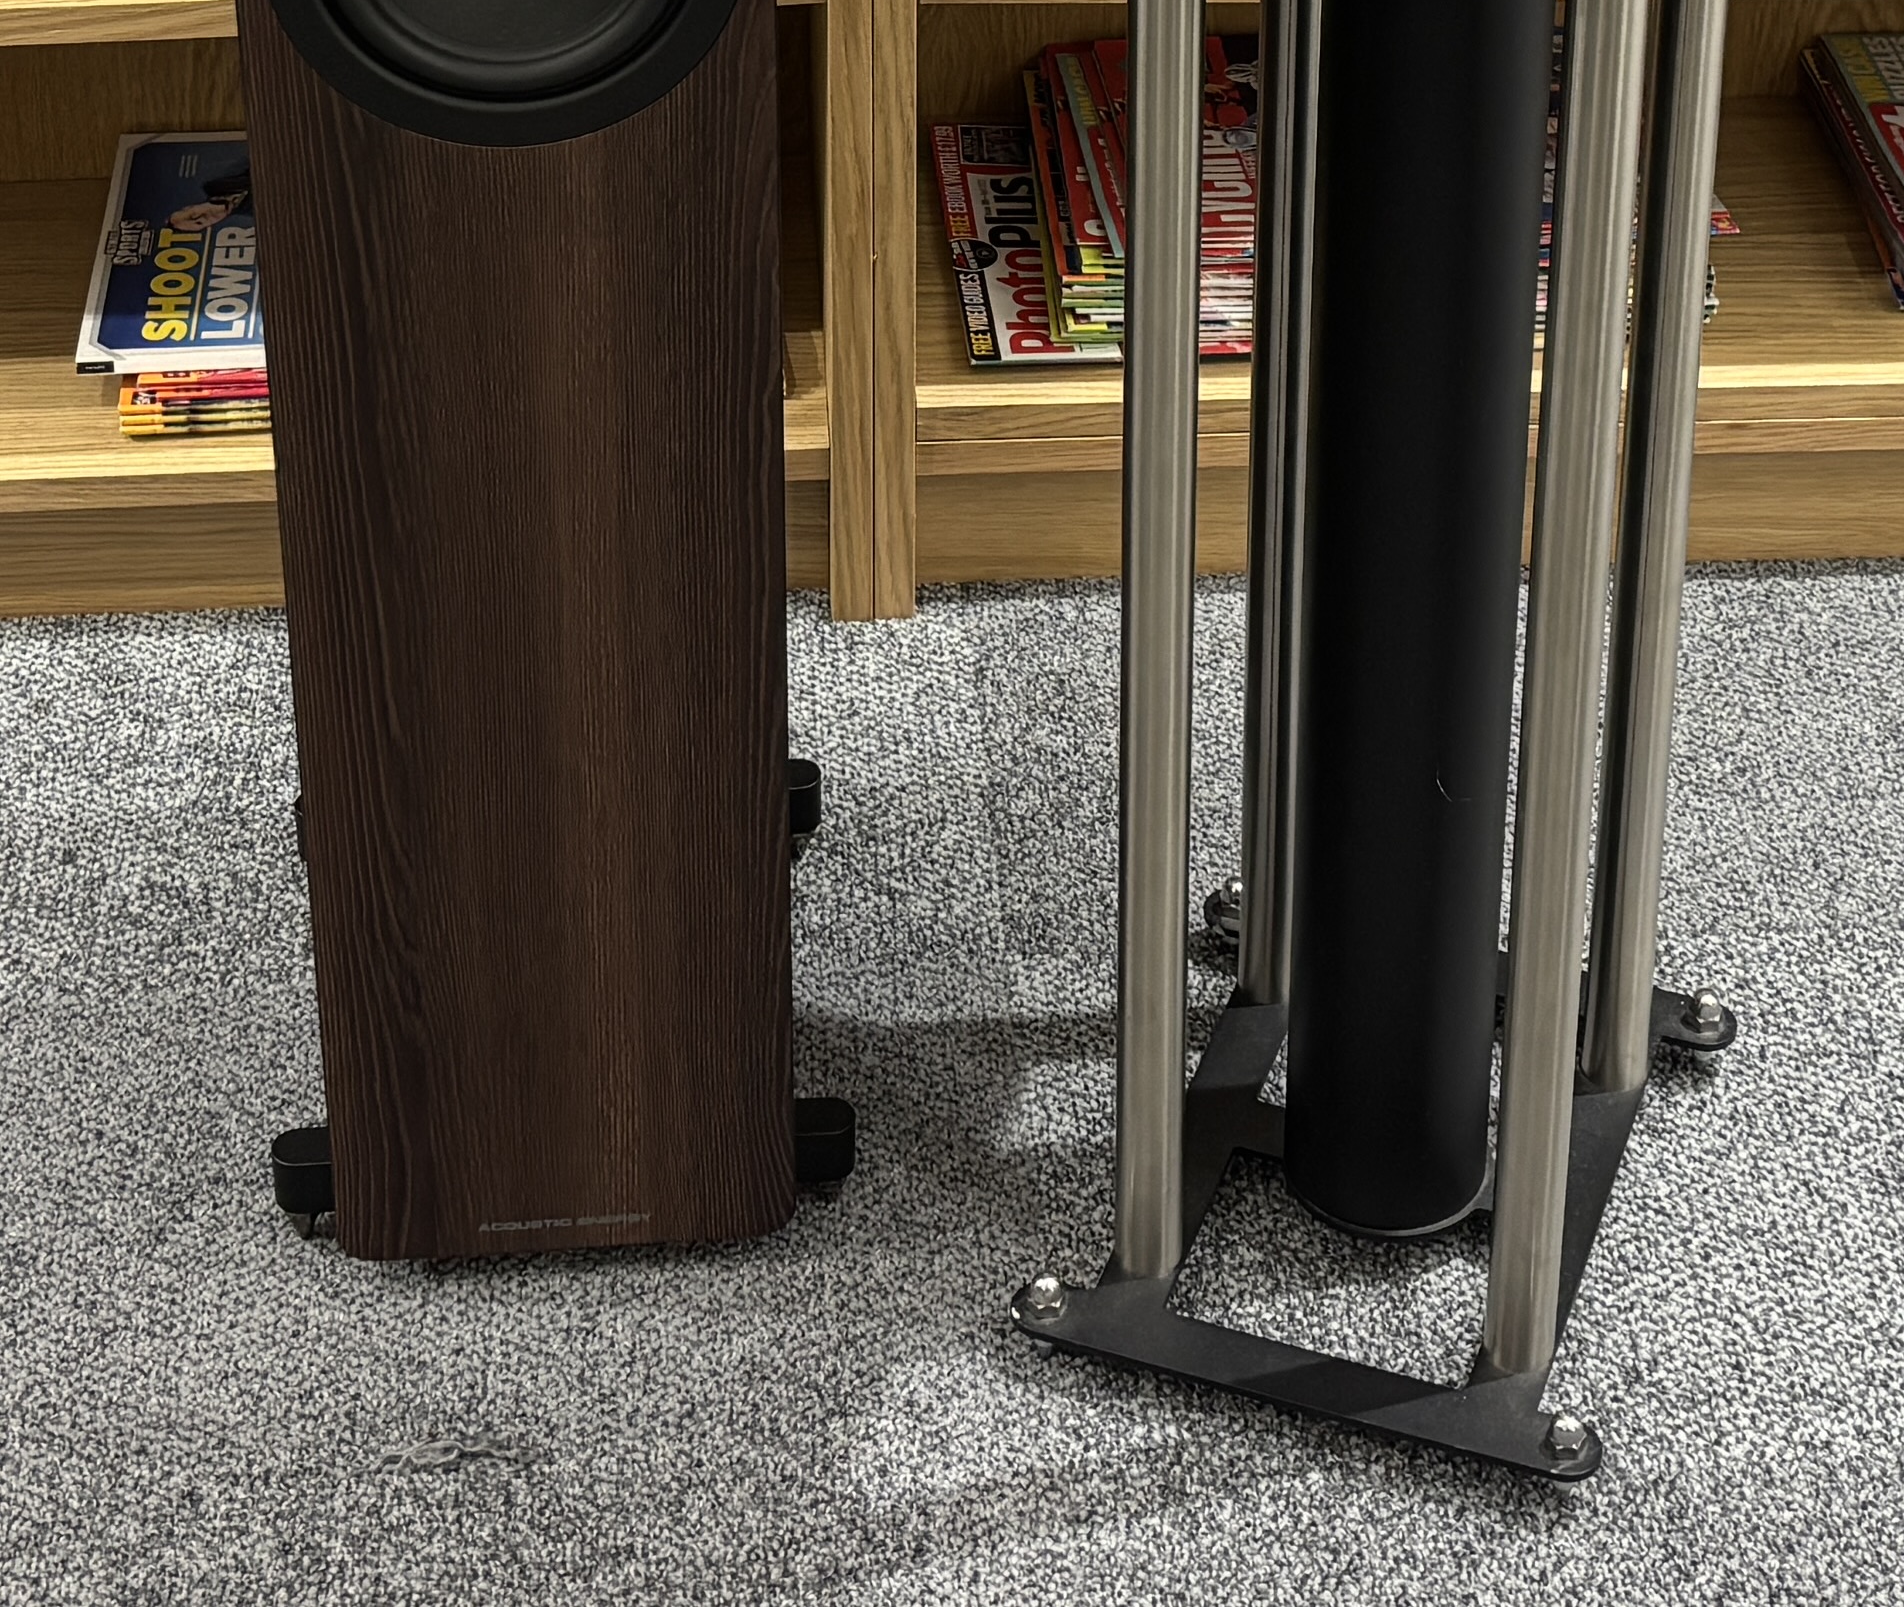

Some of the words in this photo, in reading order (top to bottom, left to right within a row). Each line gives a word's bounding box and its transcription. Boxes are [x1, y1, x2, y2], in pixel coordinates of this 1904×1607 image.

[112, 219, 147, 264] SPORTS
[140, 227, 202, 341] SHOOT
[200, 225, 264, 339] LOWER
[959, 273, 984, 303] GUIDES
[966, 305, 990, 330] VIDEO
[970, 333, 994, 354] FREE
[478, 1218, 573, 1232] ACOUSTIC
